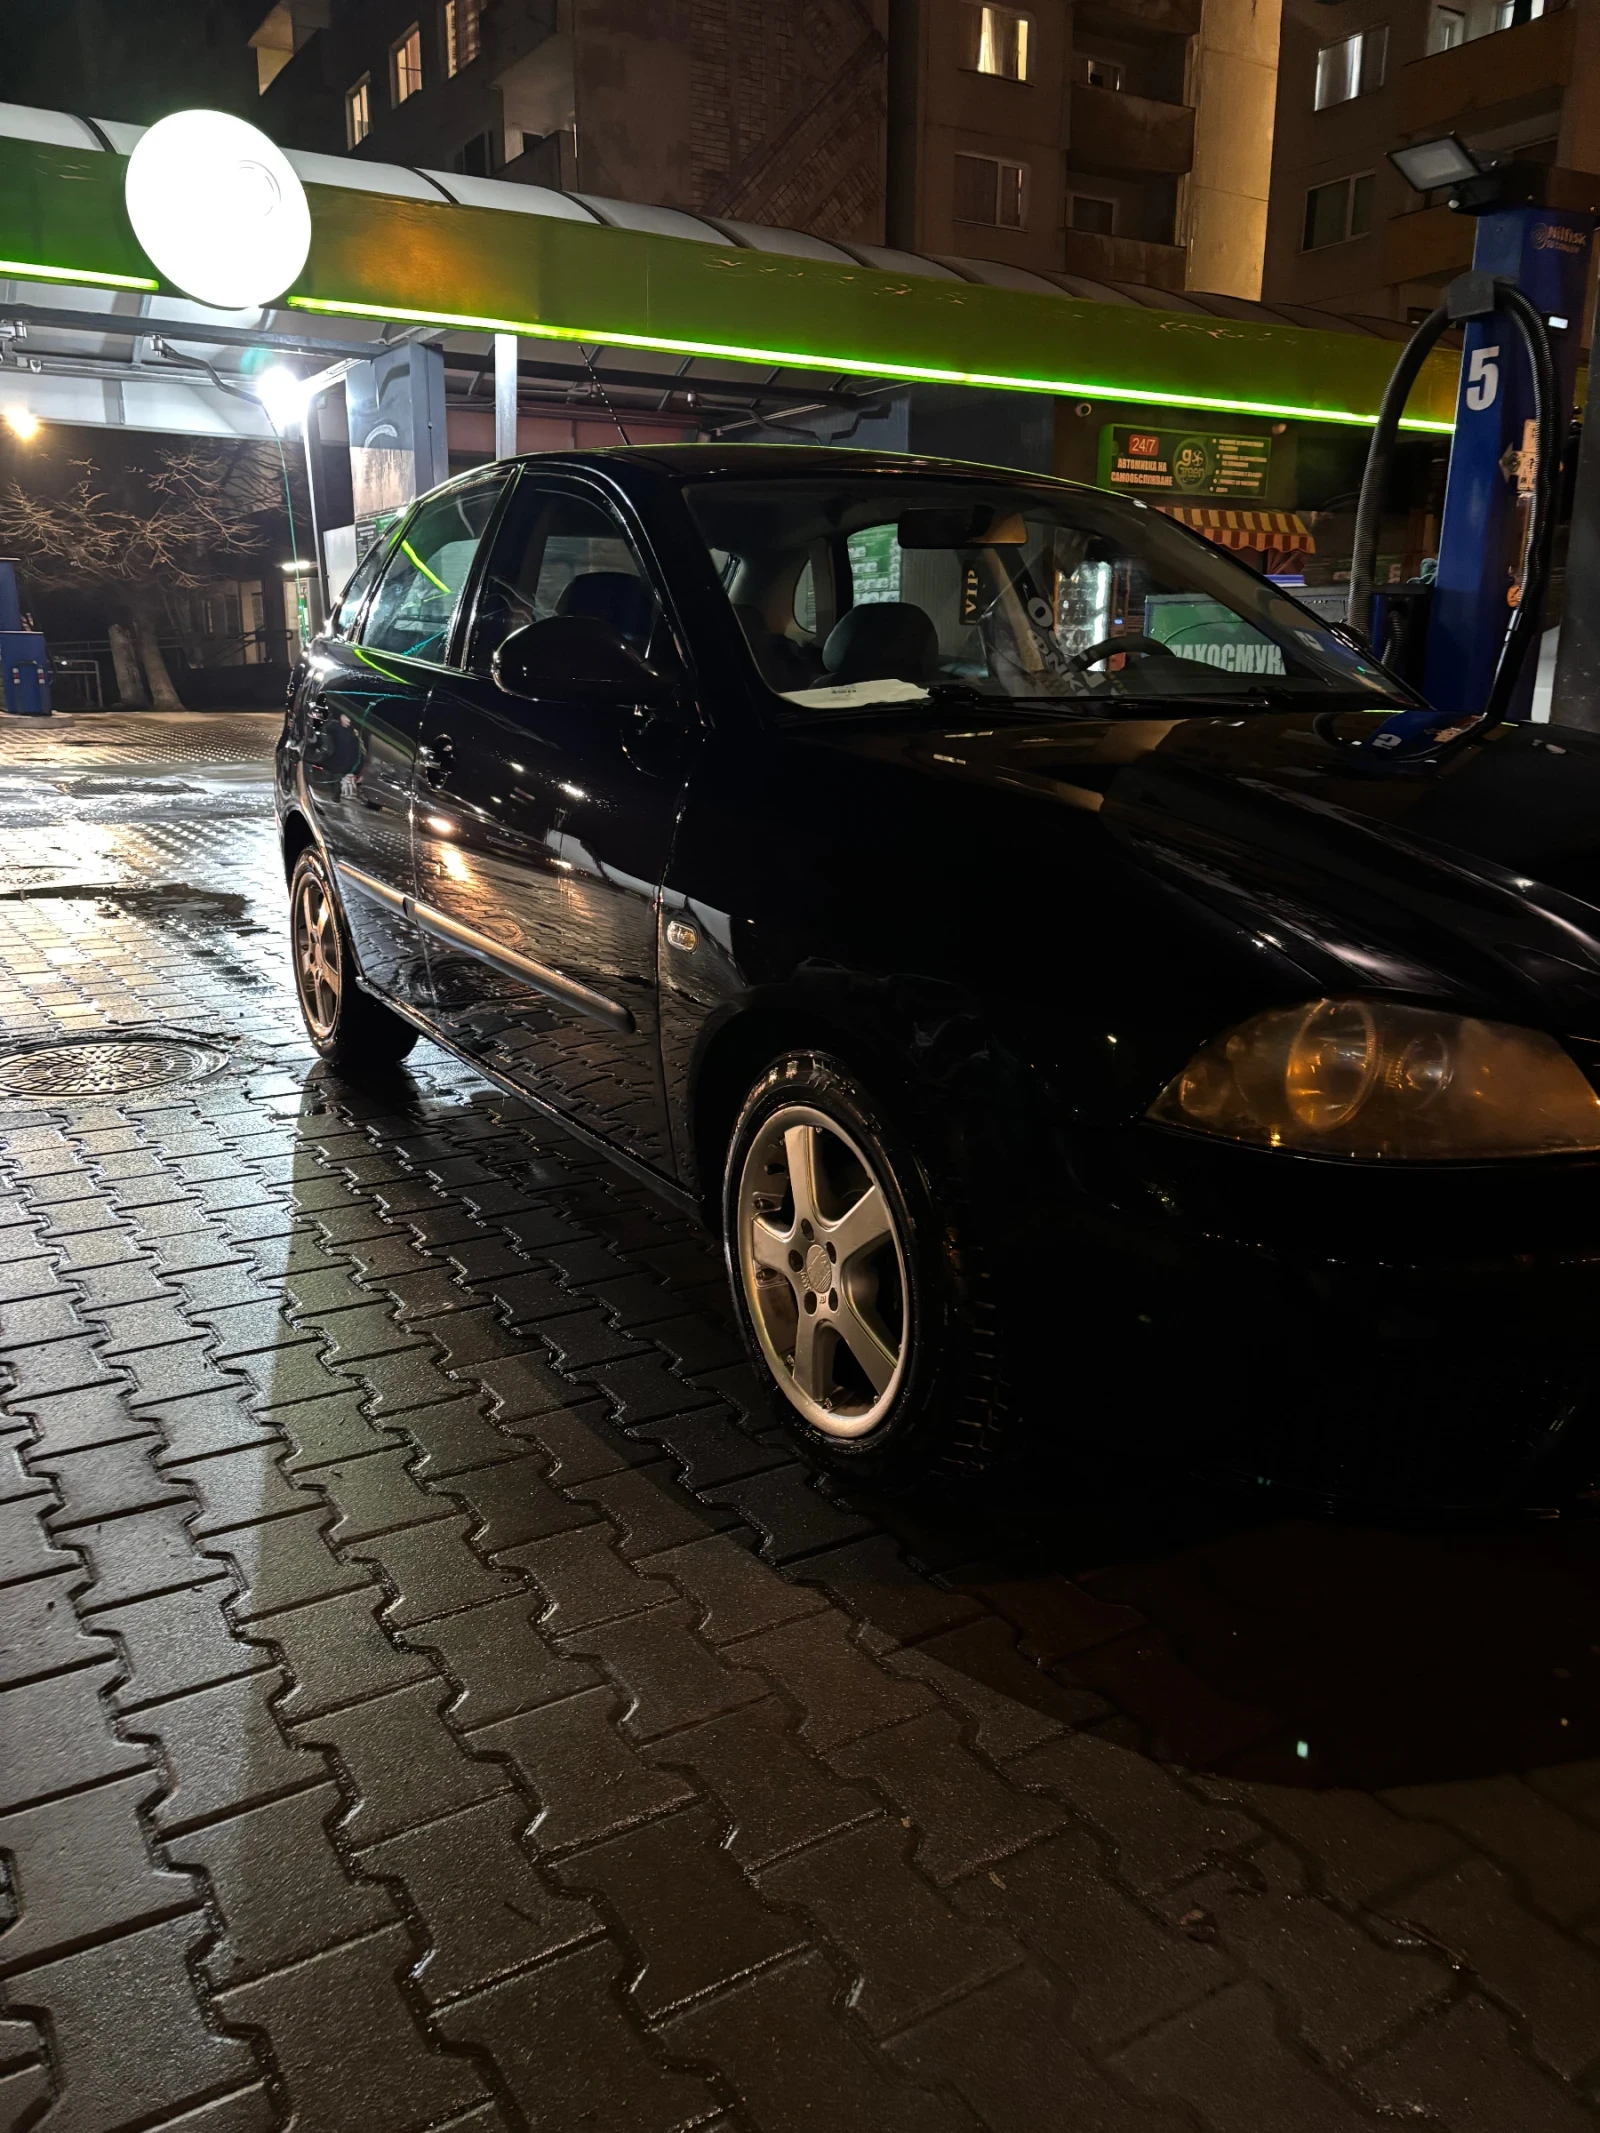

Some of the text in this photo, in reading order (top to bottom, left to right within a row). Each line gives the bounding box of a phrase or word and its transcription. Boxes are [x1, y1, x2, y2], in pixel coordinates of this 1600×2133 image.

[1466, 345, 1500, 411] 5
[1131, 437, 1156, 453] 24/7
[1117, 458, 1167, 472] АВТОМИВКА НА
[965, 569, 979, 615] VIP
